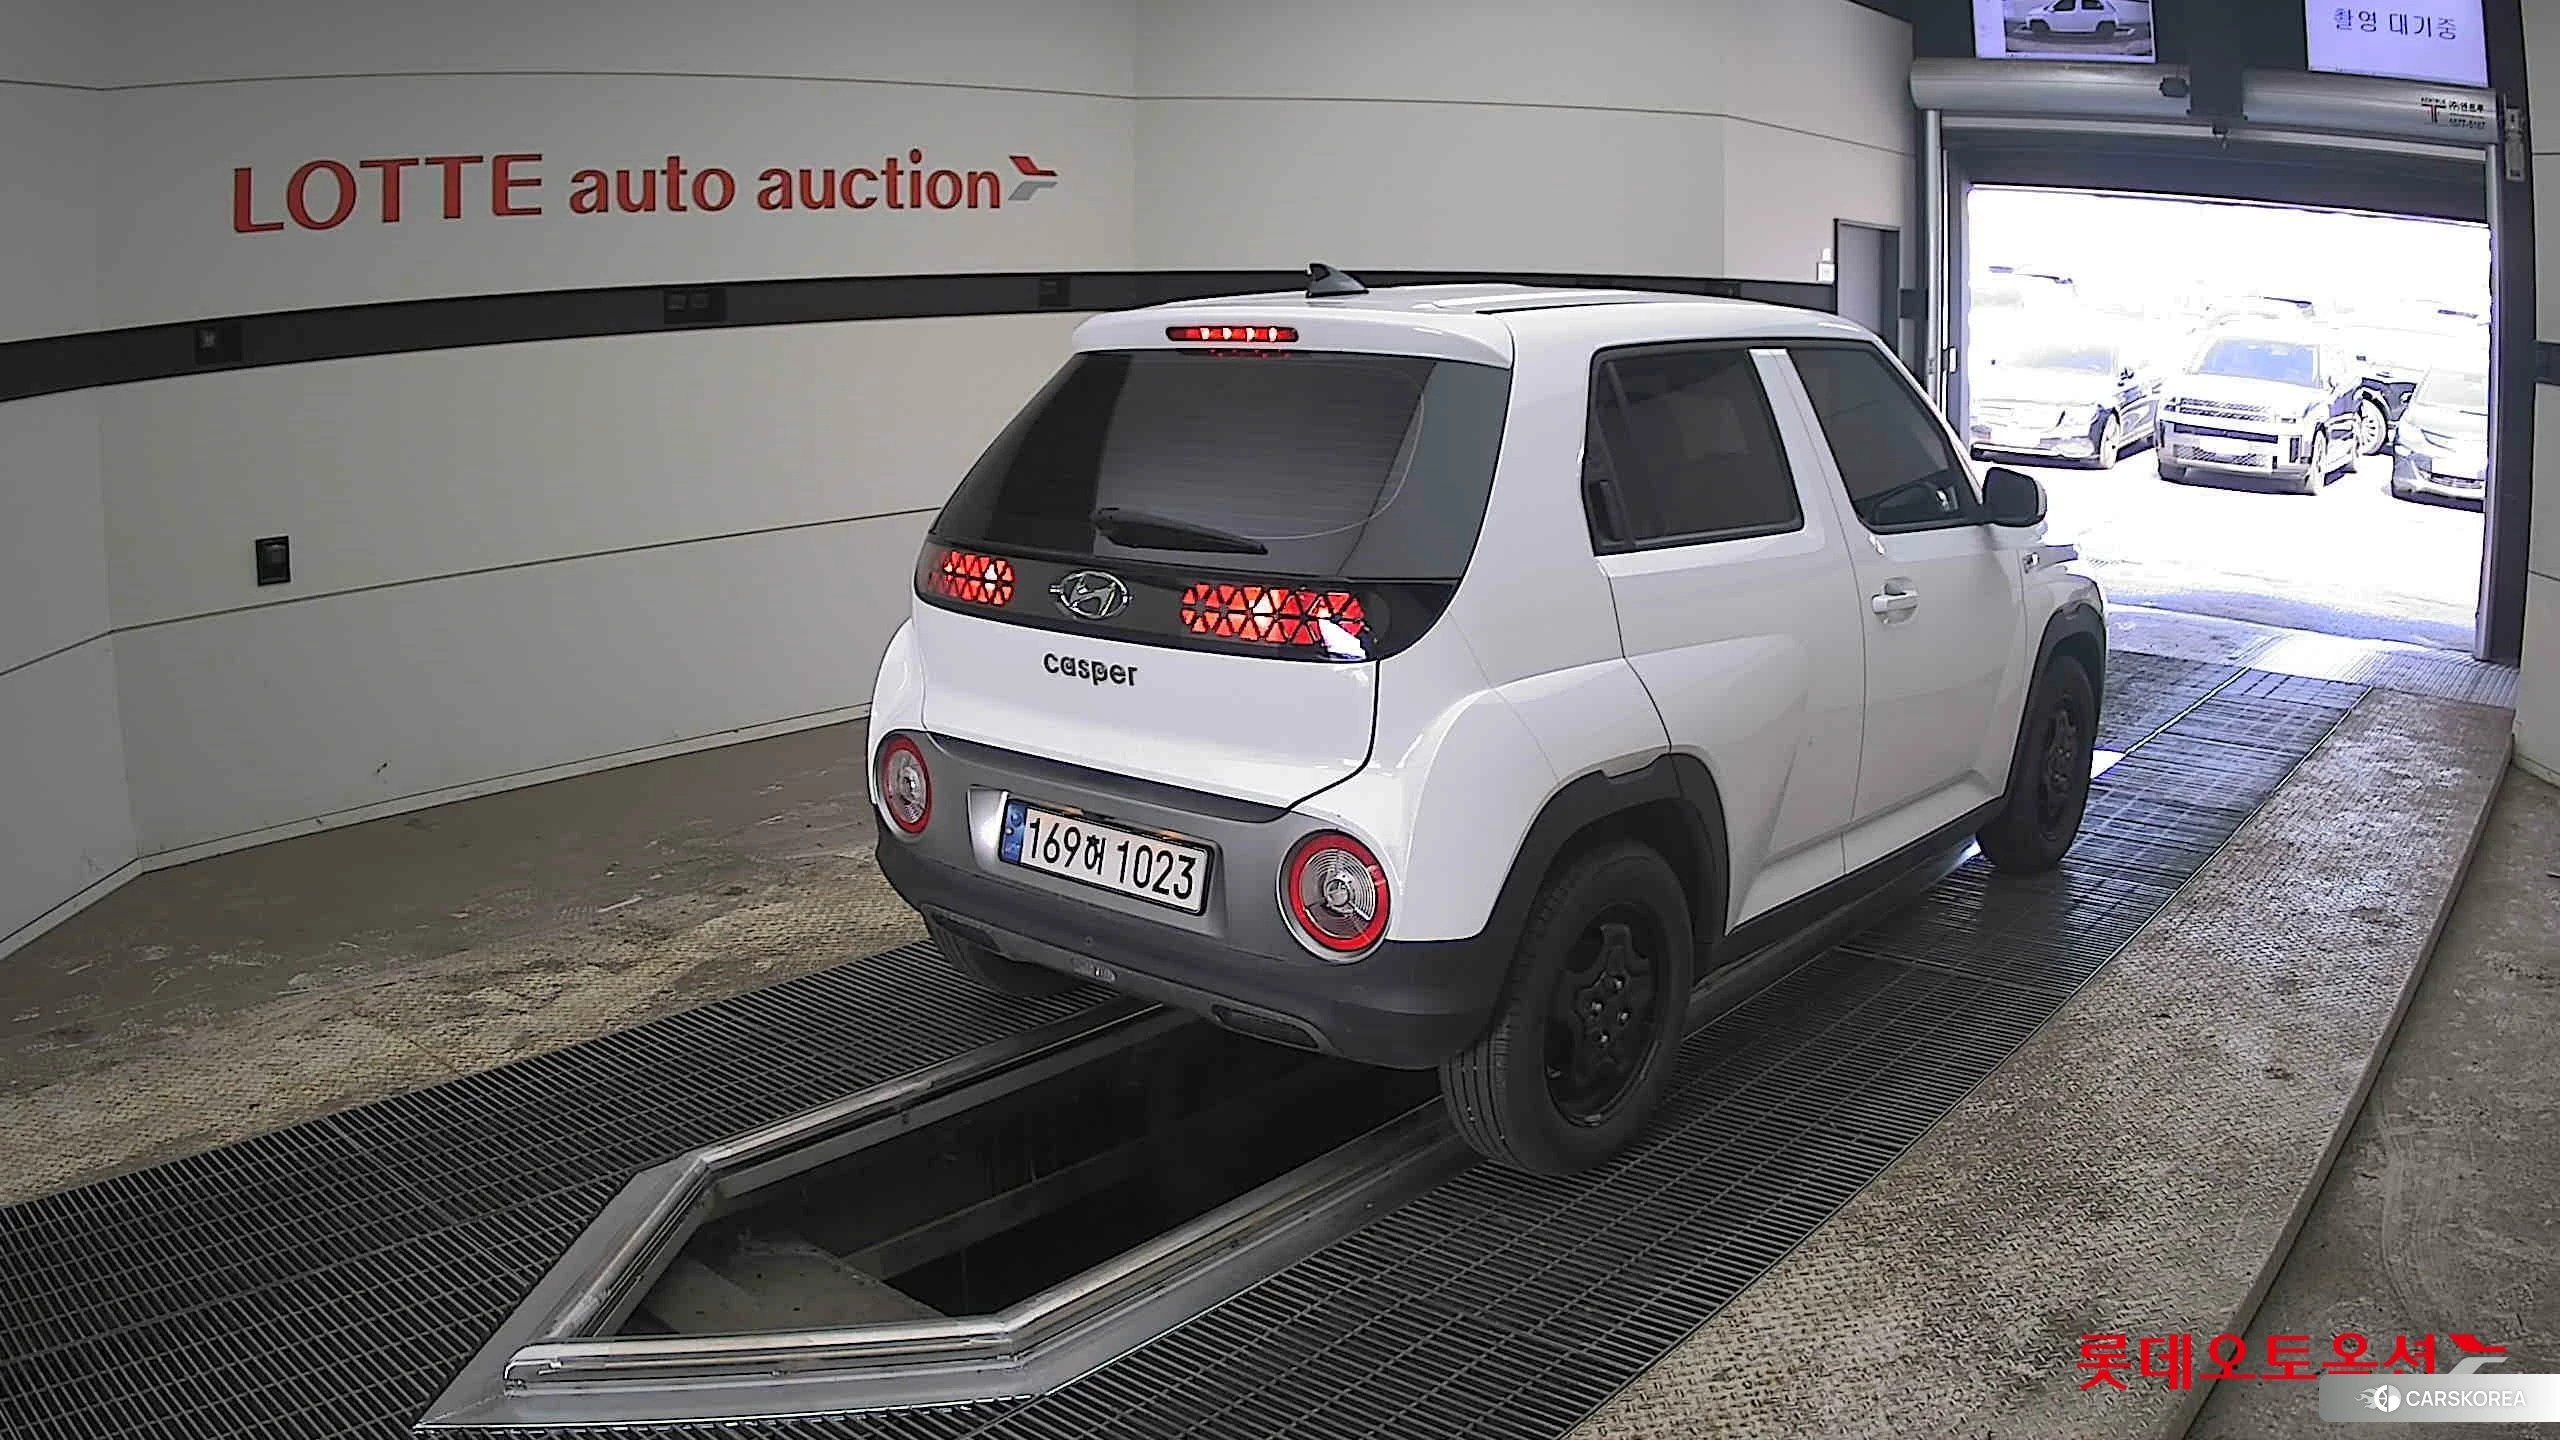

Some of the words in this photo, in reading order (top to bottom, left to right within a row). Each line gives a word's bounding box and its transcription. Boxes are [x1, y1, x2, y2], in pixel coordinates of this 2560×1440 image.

[2334, 8, 2378, 33] 촬영
[2389, 13, 2457, 41] 대기중
[233, 153, 543, 233] LOTTE
[569, 155, 736, 214] auto
[757, 148, 1002, 211] auction
[1043, 653, 1138, 687] casper
[1029, 817, 1107, 876] 169허
[1117, 840, 1197, 900] 1023
